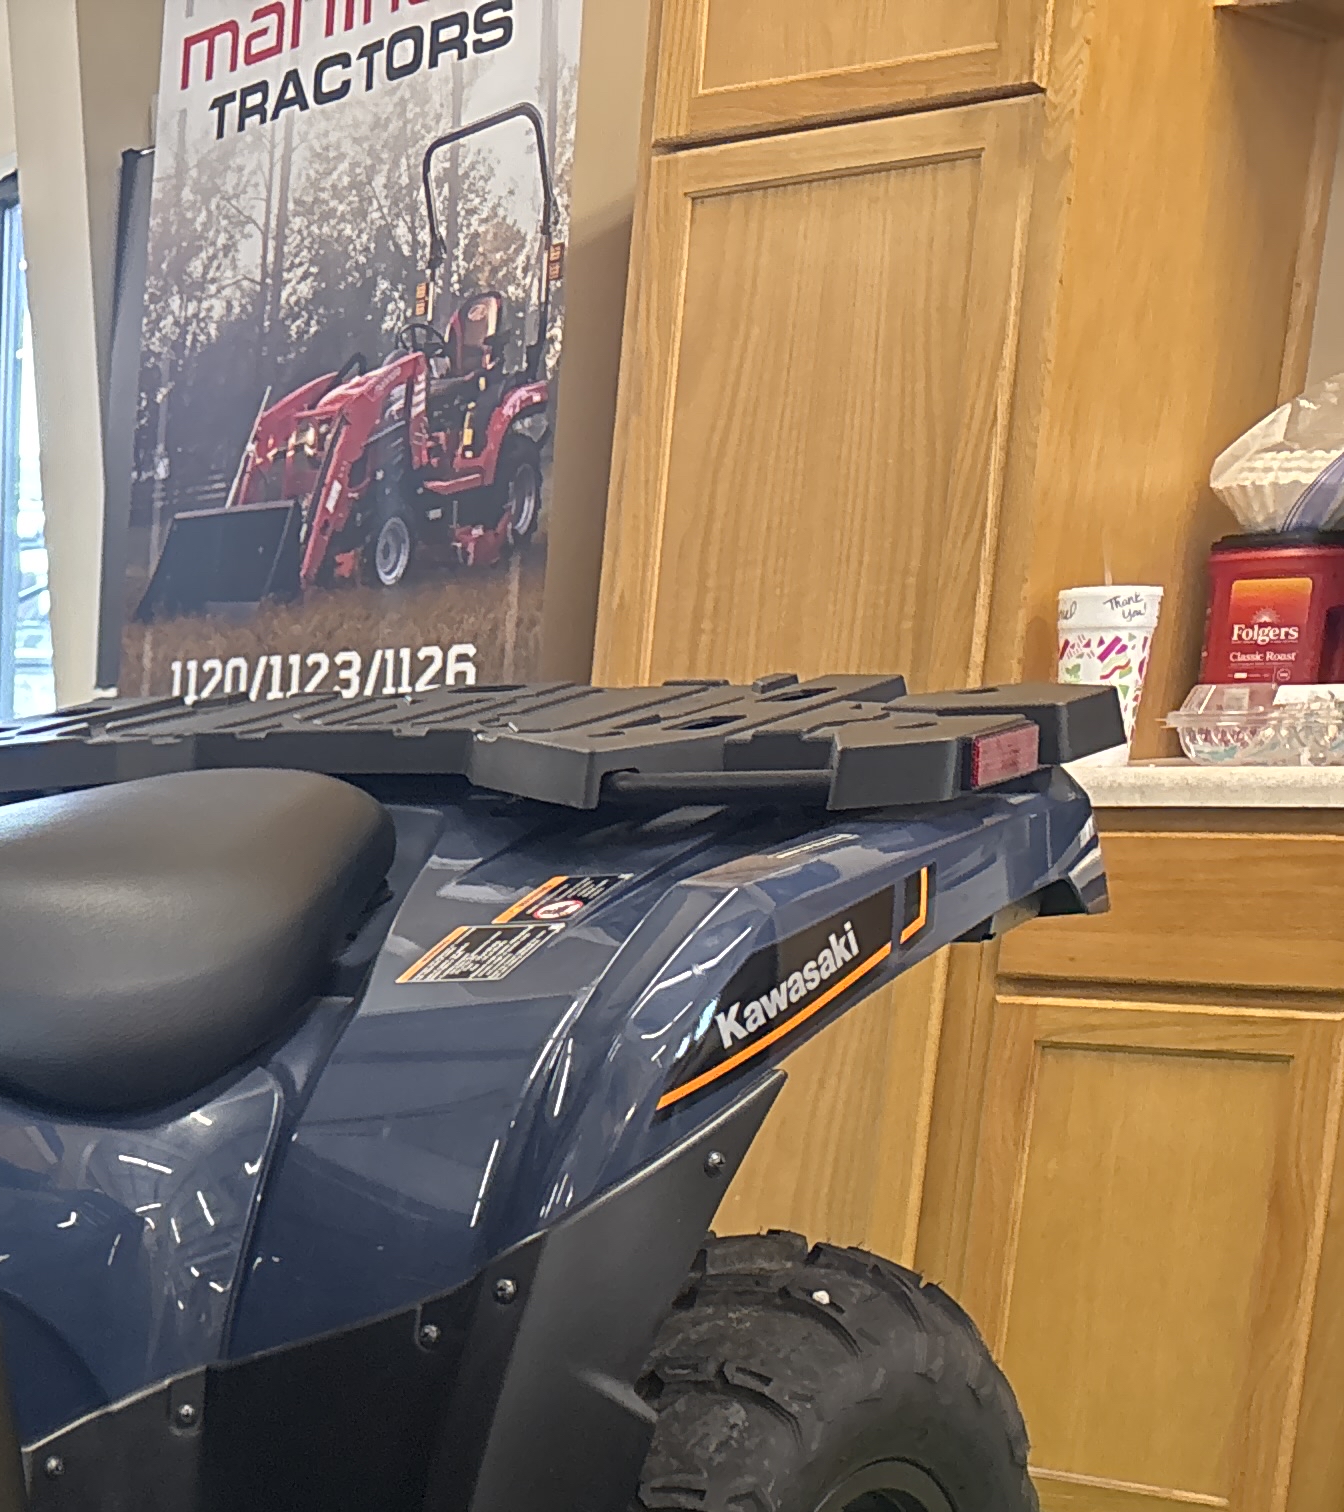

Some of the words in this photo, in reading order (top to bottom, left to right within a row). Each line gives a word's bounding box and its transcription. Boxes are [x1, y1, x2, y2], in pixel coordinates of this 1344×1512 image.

[208, 0, 513, 140] TRACTORS
[1103, 592, 1144, 611] Thank
[1231, 623, 1300, 646] Folgers
[1229, 651, 1264, 662] Classic
[1265, 651, 1297, 662] Roast
[714, 920, 860, 1050] Kawasaki
